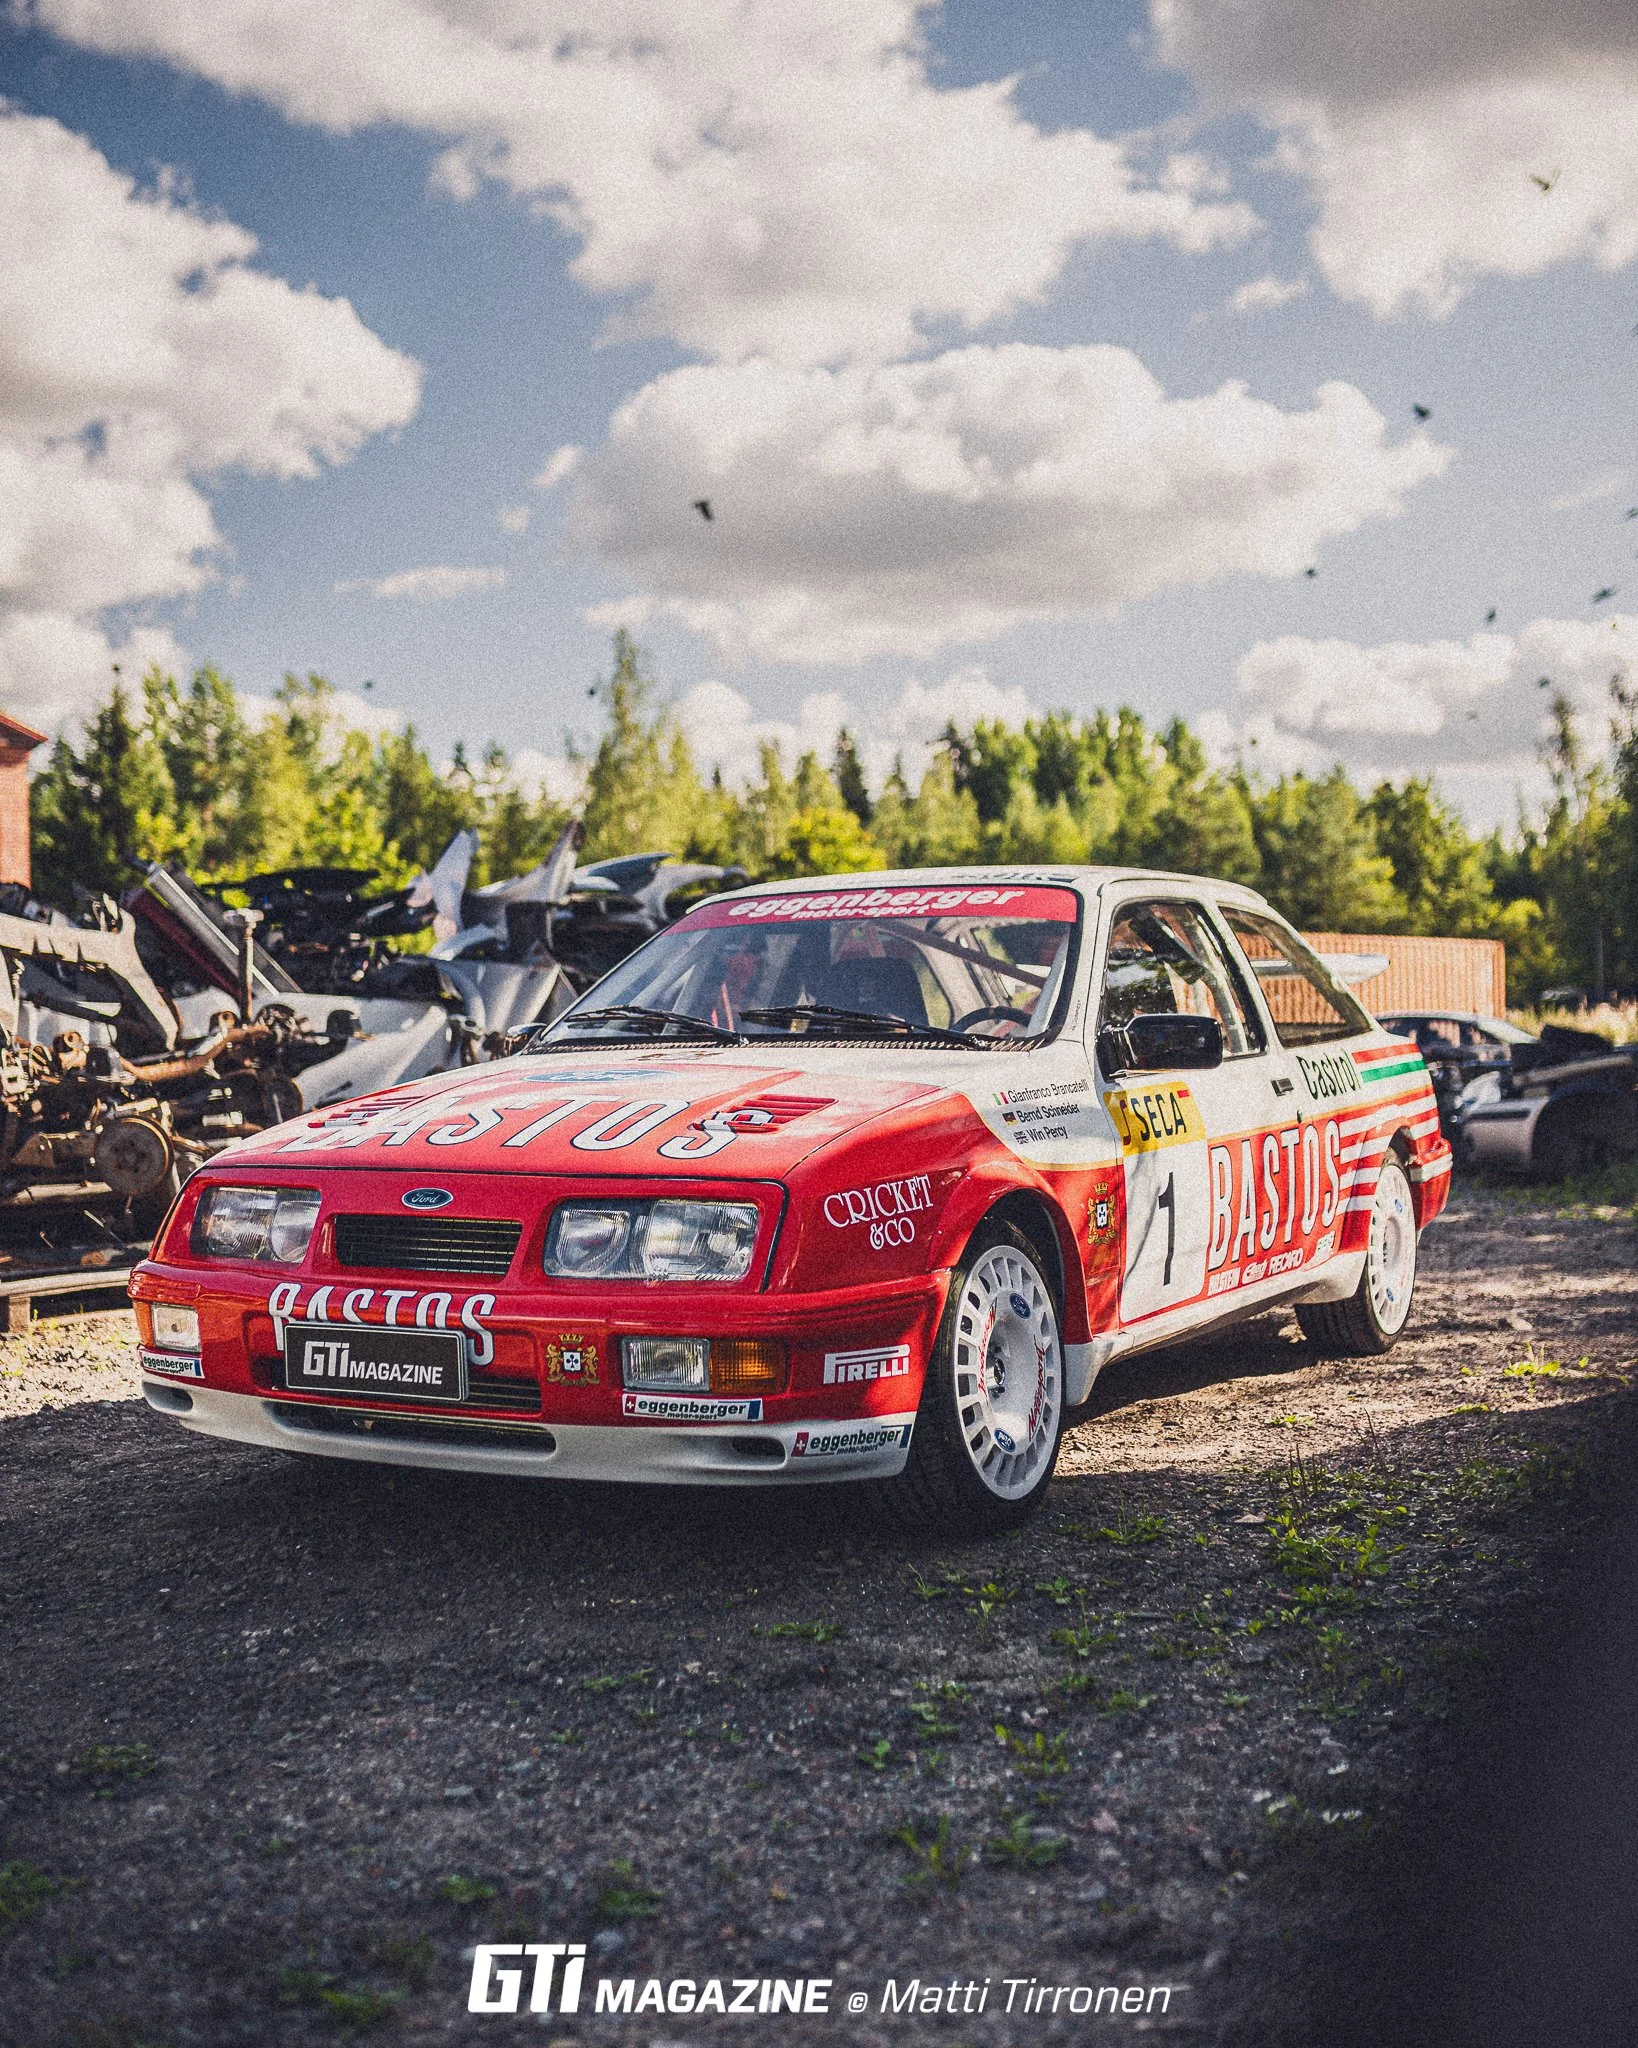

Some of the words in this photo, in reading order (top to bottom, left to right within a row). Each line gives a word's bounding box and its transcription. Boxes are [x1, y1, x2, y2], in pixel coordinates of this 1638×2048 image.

[728, 889, 1026, 918] eggenberger
[1296, 1048, 1361, 1100] Castrol
[1007, 1087, 1051, 1103] Gianfranco
[1016, 1107, 1043, 1123] Bernd
[1041, 1102, 1081, 1120] Schneider
[1130, 1092, 1188, 1142] SECA
[1026, 1127, 1045, 1142] Win
[1043, 1125, 1069, 1139] Percy
[411, 1191, 440, 1203] Ford
[823, 1174, 934, 1228] CRICKET
[1208, 1120, 1341, 1271] BASTOS
[869, 1216, 915, 1250] &CO
[1158, 1172, 1176, 1286] 1
[143, 1356, 194, 1371] eggenberger
[350, 1360, 443, 1385] MAGAZINE
[823, 1344, 910, 1384] PIRELLI
[637, 1399, 747, 1418] eggenberger
[810, 1428, 902, 1452] eggenberger
